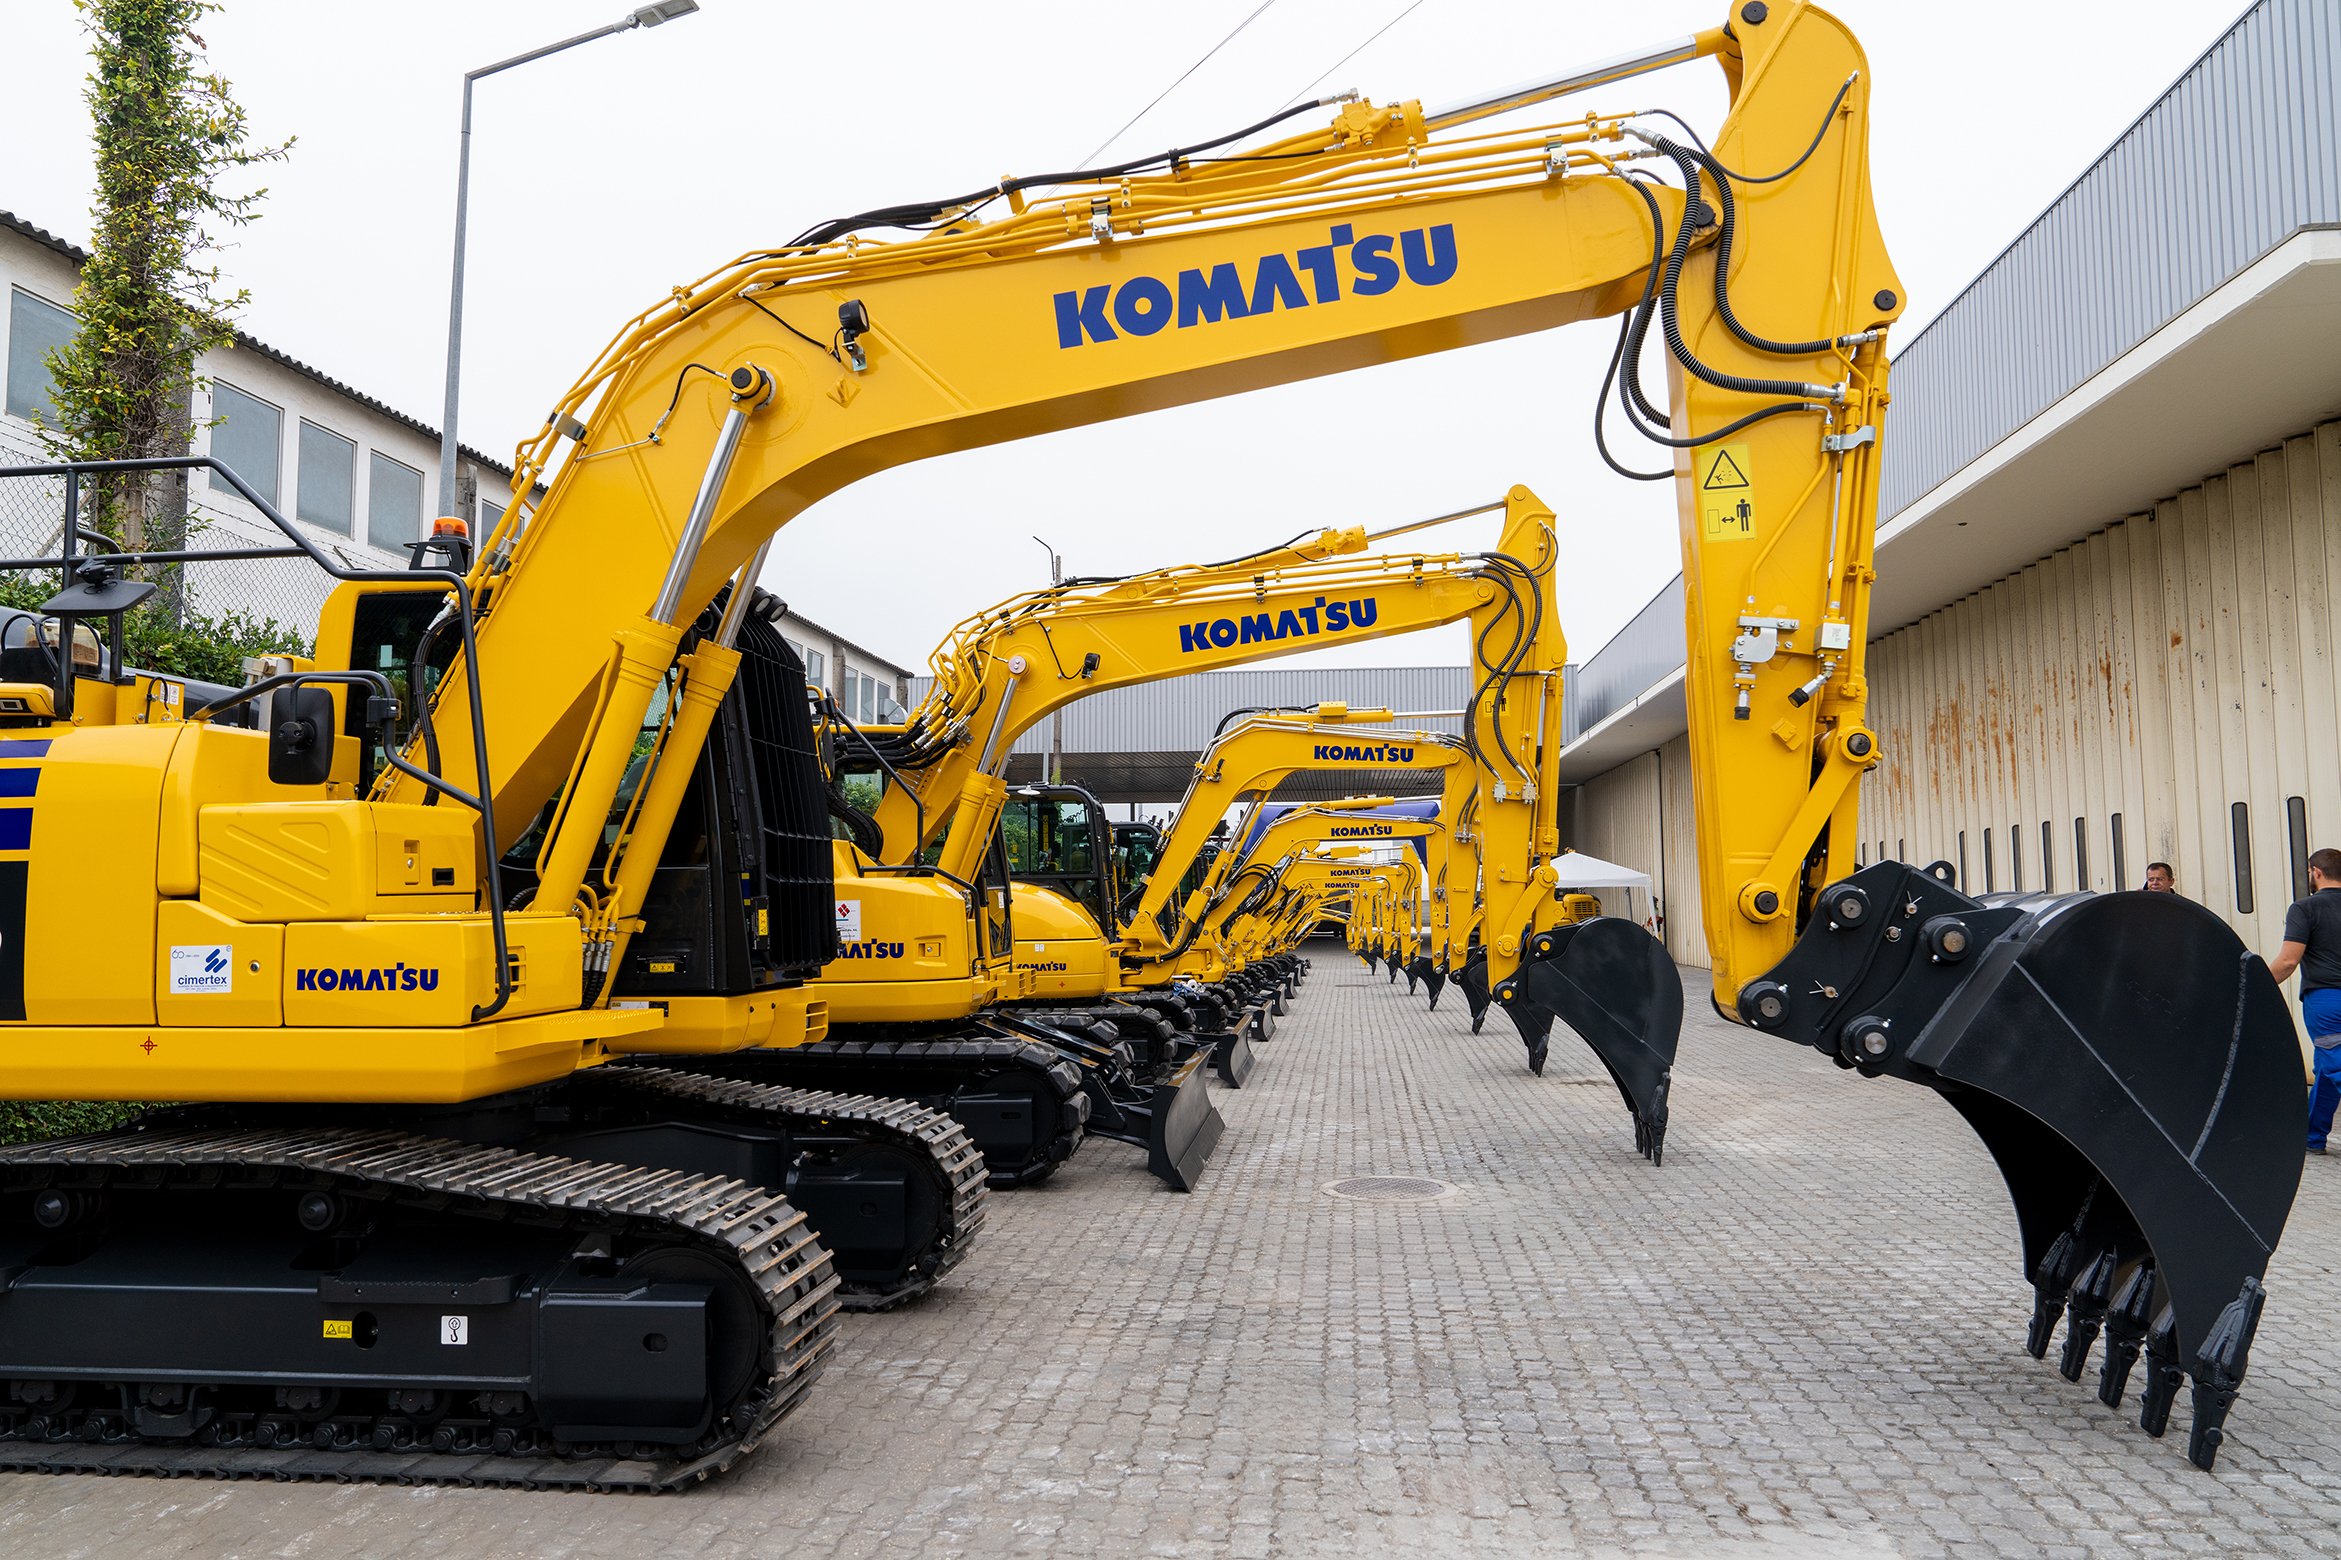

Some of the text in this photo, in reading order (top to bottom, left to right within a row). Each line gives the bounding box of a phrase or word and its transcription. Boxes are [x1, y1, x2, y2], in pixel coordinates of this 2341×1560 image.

[1053, 223, 1459, 350] KOMATSU
[1179, 596, 1378, 653] KOMATSU
[1314, 743, 1414, 763] KOMATSU
[1330, 823, 1393, 837] KOMATSU
[1330, 867, 1371, 877] KOMATSU
[1325, 881, 1360, 889] KOMATSU
[837, 938, 905, 959] MATSU
[177, 974, 228, 985] cimertex
[297, 962, 439, 992] KOMATSU
